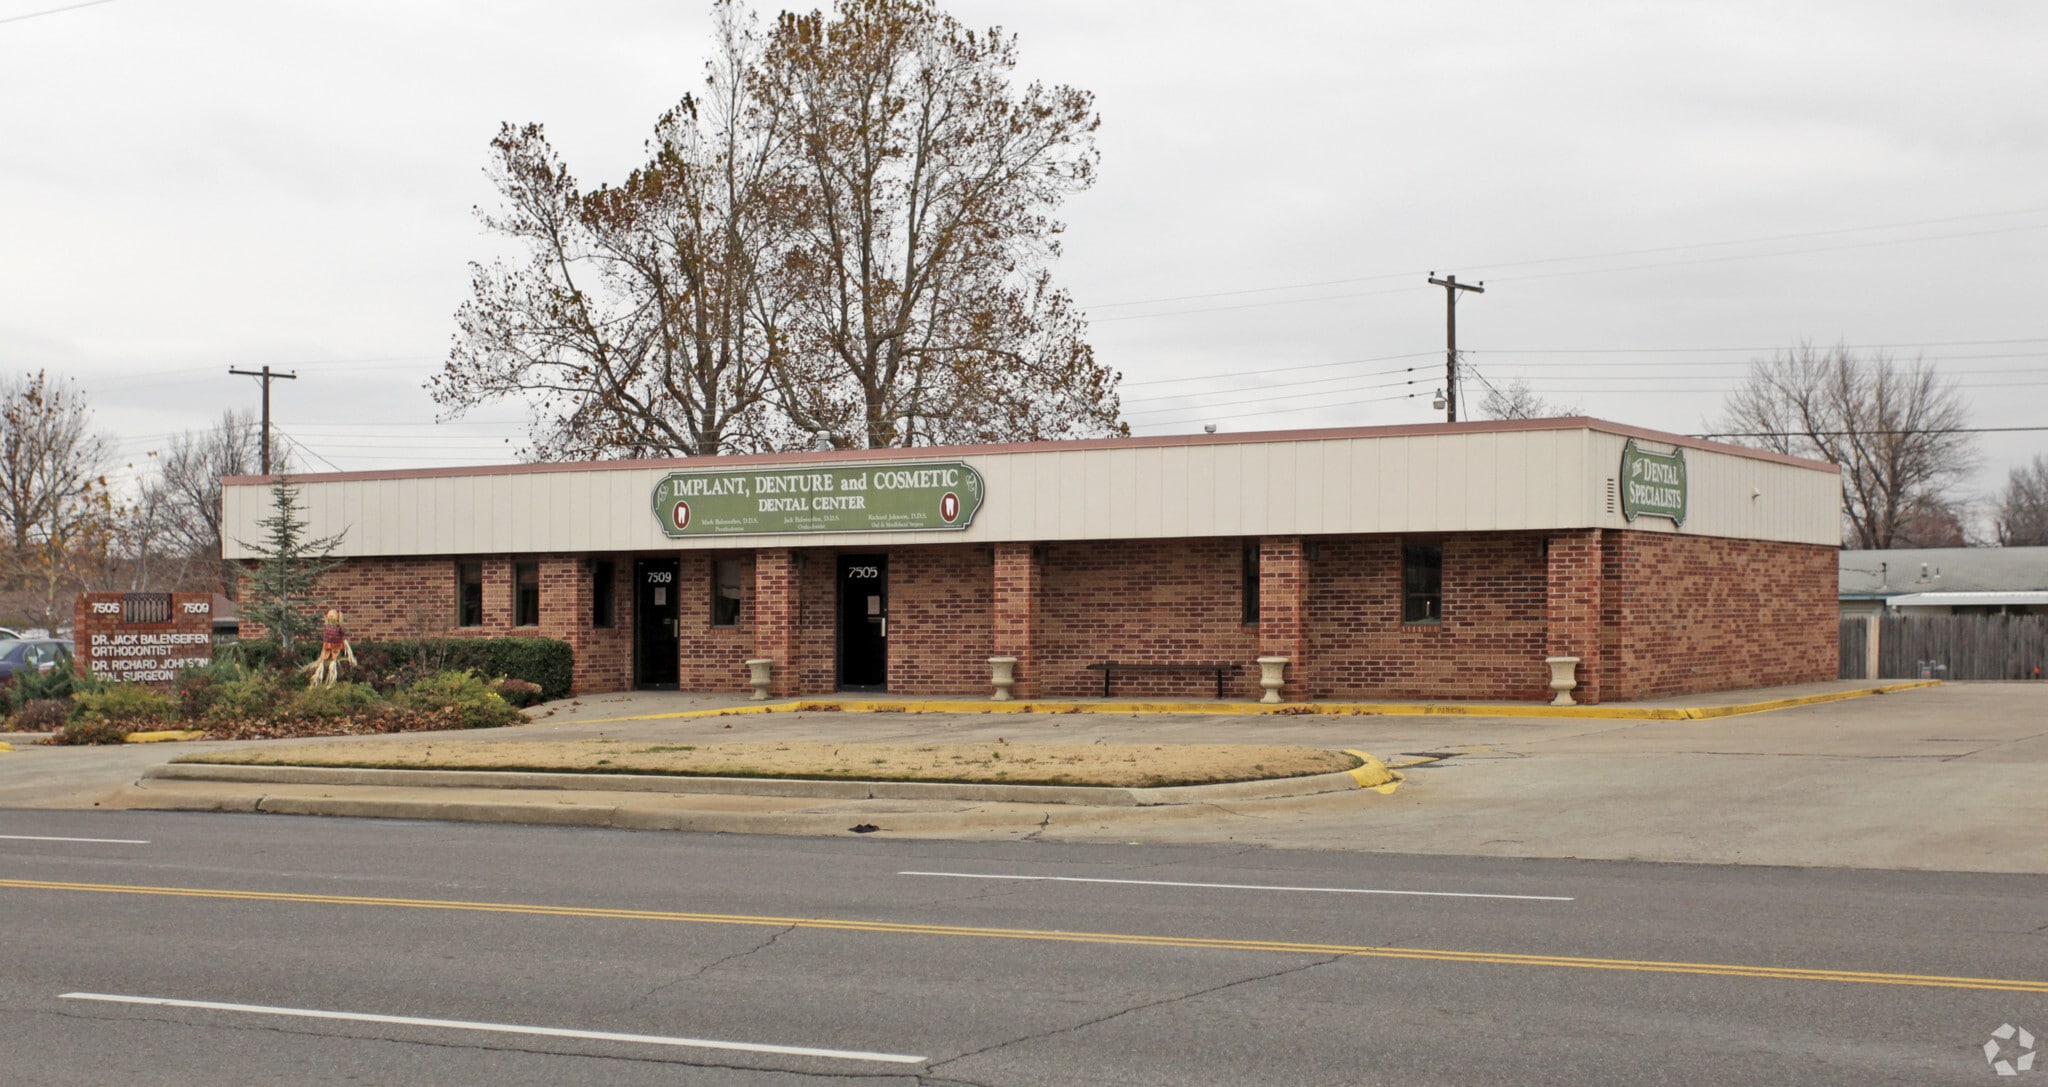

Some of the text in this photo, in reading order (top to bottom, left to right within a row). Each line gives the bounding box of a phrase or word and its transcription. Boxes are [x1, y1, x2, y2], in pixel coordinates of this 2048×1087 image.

[1644, 458, 1679, 485] DENTAL
[673, 469, 959, 497] IMPLANT, DENTURE and COSMETIC
[1629, 480, 1682, 509] SPECIALISTS
[758, 496, 865, 512] DENTAL CENTER
[647, 571, 672, 583] 7509
[848, 566, 878, 578] 7505
[91, 602, 120, 614] 7505
[182, 602, 209, 614] 7509
[91, 633, 209, 646] DR. JACK BALENSEIFEN
[91, 645, 174, 657] ORTHODONTIST
[91, 660, 110, 671] DR.
[111, 659, 157, 671] RICHARD
[123, 670, 174, 682] SURGEON
